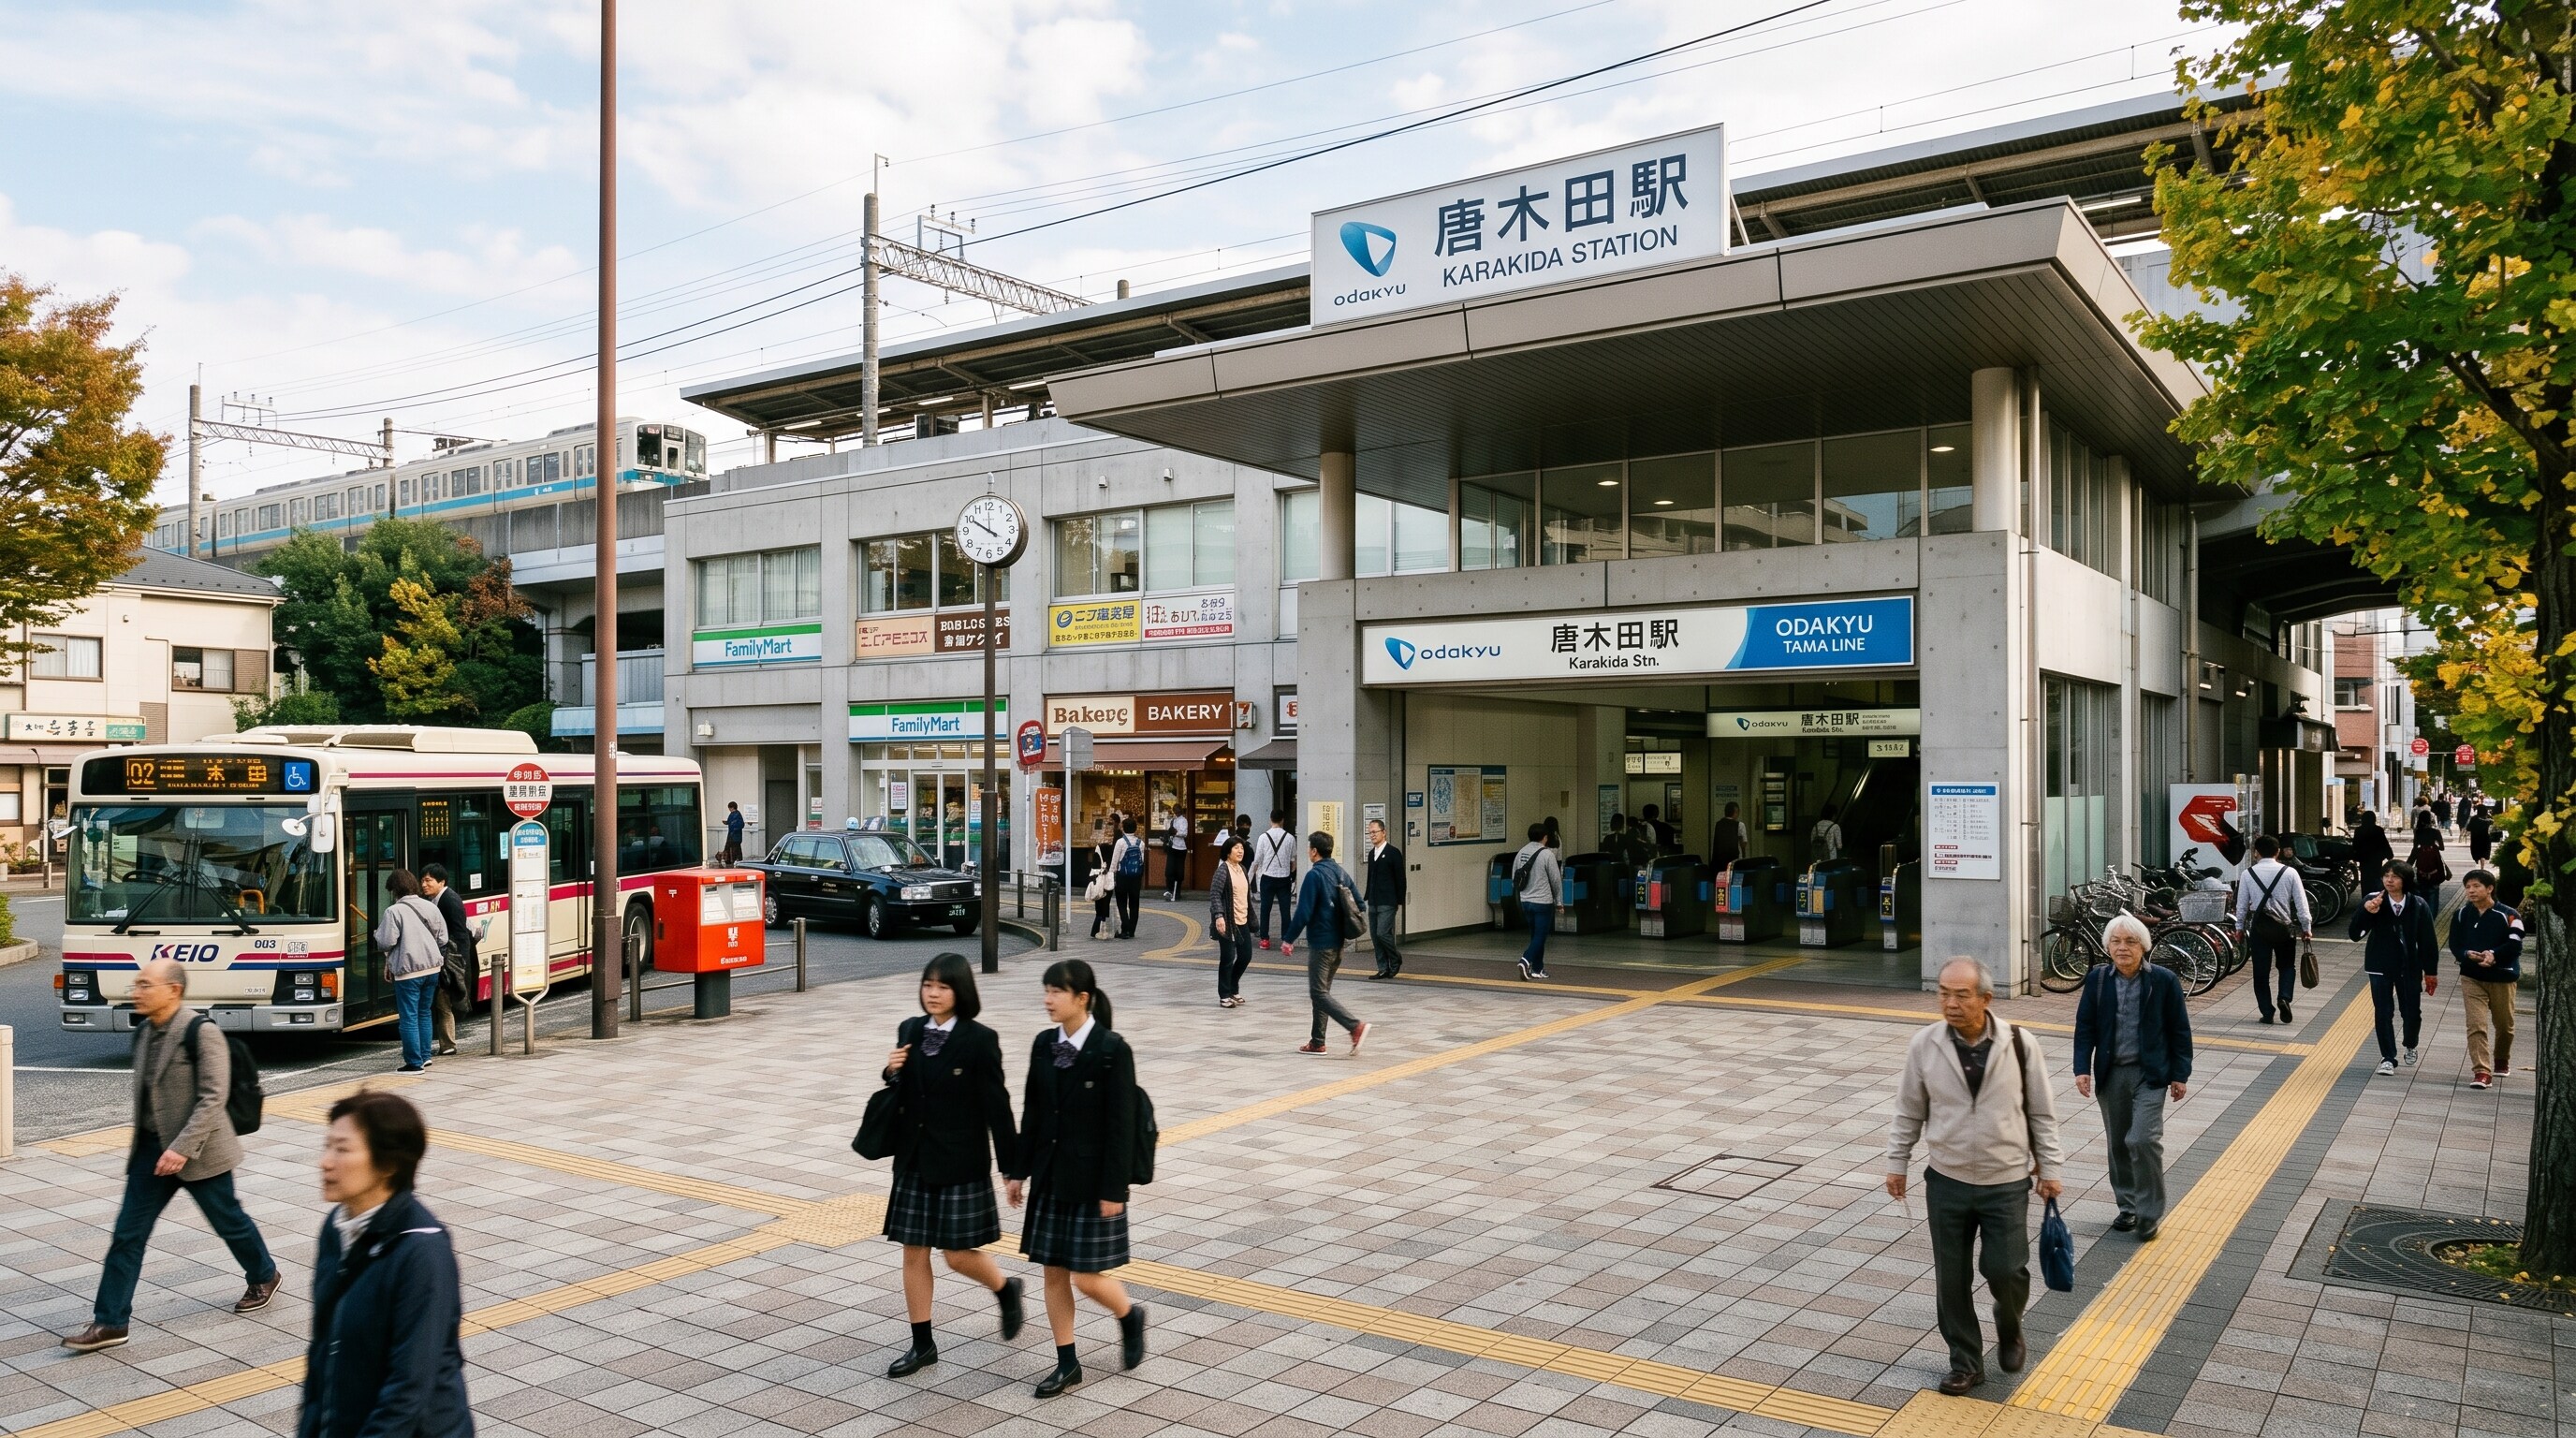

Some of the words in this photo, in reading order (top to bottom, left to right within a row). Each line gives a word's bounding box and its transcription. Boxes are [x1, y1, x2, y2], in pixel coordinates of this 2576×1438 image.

[1434, 153, 1689, 258] 唐木田駅
[1442, 247, 1564, 288] KARAKIDA
[1571, 225, 1678, 264] STATION
[985, 502, 994, 511] 12
[965, 515, 974, 523] 10
[1005, 513, 1013, 522] 2
[962, 526, 970, 536] 9
[1008, 525, 1015, 535] 3
[1004, 538, 1012, 547] 4
[975, 547, 982, 557] 7
[986, 549, 992, 559] 6
[996, 547, 1003, 556] 5
[1776, 614, 1873, 637] ODAKYU
[1550, 618, 1679, 653] 唐木田駅
[724, 638, 792, 658] FamilyMart
[1420, 644, 1501, 661] odakyu
[1783, 639, 1829, 653] TAMA
[1832, 638, 1866, 652] LINE
[1569, 654, 1629, 669] Karakida
[1632, 653, 1660, 668] Stn.
[1148, 703, 1223, 721] BAKERY
[892, 716, 960, 735] FamilyMart
[150, 944, 220, 962] KEIO
